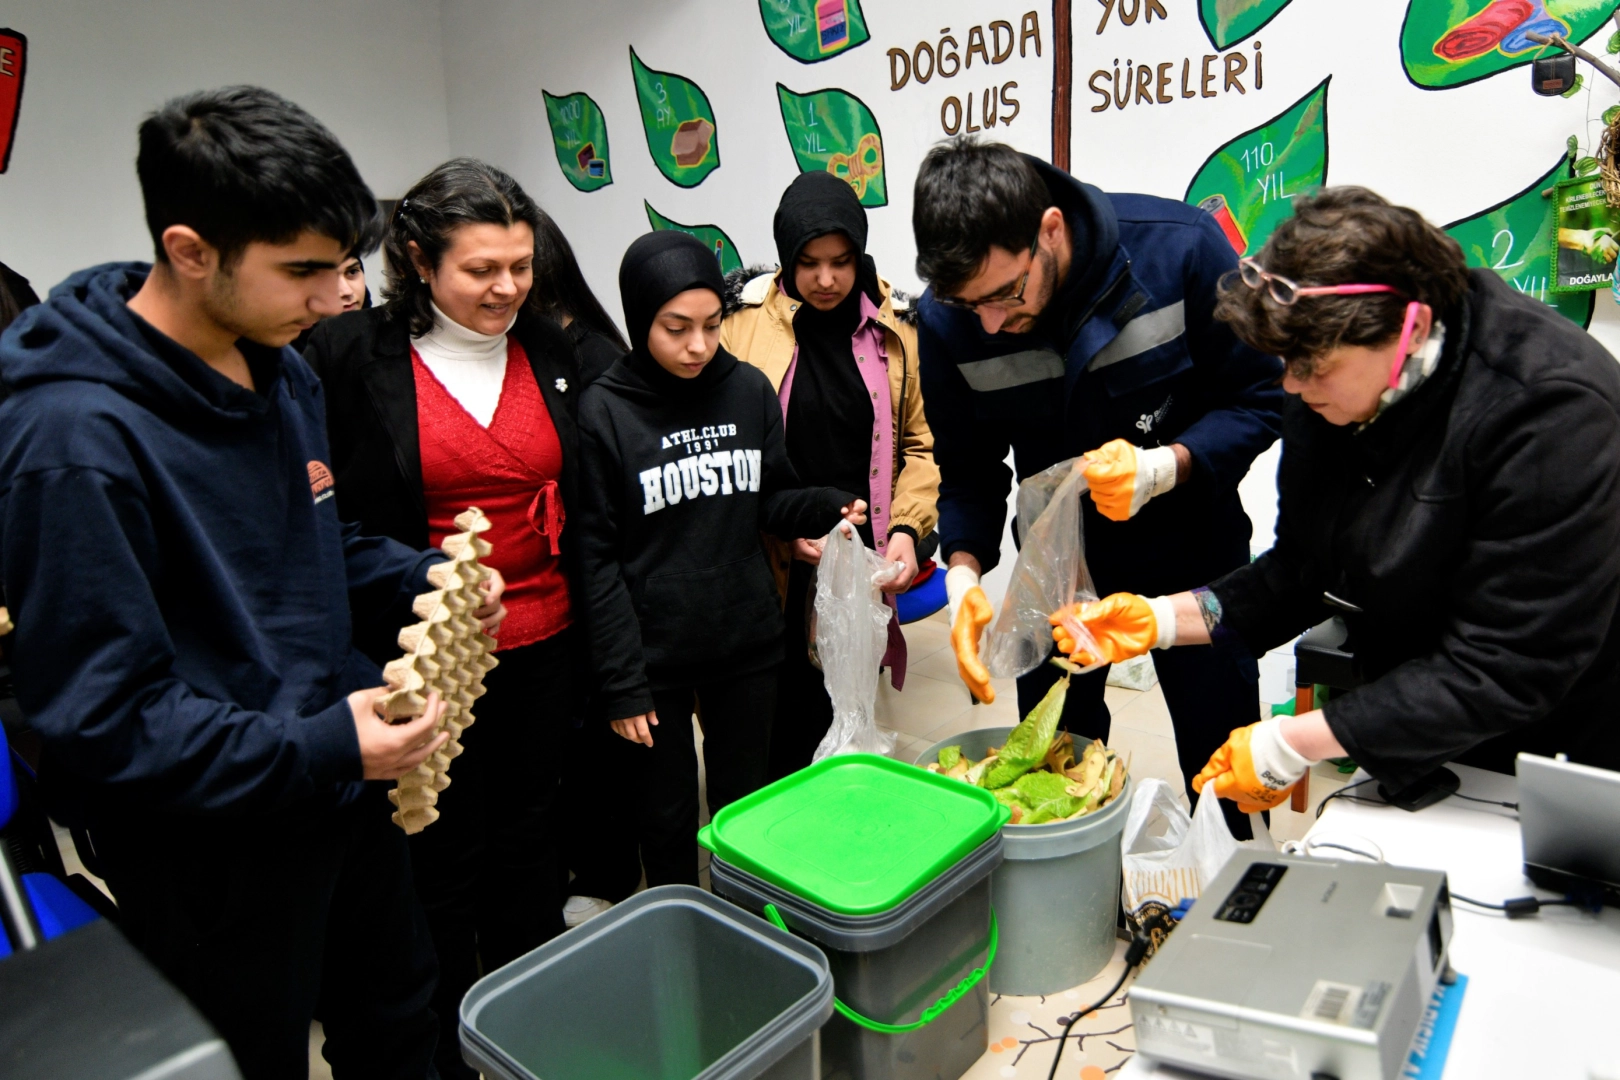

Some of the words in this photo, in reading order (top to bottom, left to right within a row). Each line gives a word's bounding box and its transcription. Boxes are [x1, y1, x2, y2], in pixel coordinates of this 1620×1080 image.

[786, 14, 807, 37] YIL
[886, 10, 1042, 92] DOĞADA
[655, 82, 667, 104] 3
[940, 81, 1021, 137] OLUŞ
[1088, 41, 1263, 113] SÜRELERİ
[656, 105, 671, 129] AY
[808, 101, 818, 127] 1
[804, 132, 827, 154] YIL
[1240, 142, 1274, 173] 110
[1256, 171, 1297, 205] YIL
[1491, 229, 1525, 270] 2
[1569, 272, 1613, 285] DOĞAYLA
[686, 438, 719, 454] 1991
[639, 449, 762, 516] HOUSTON
